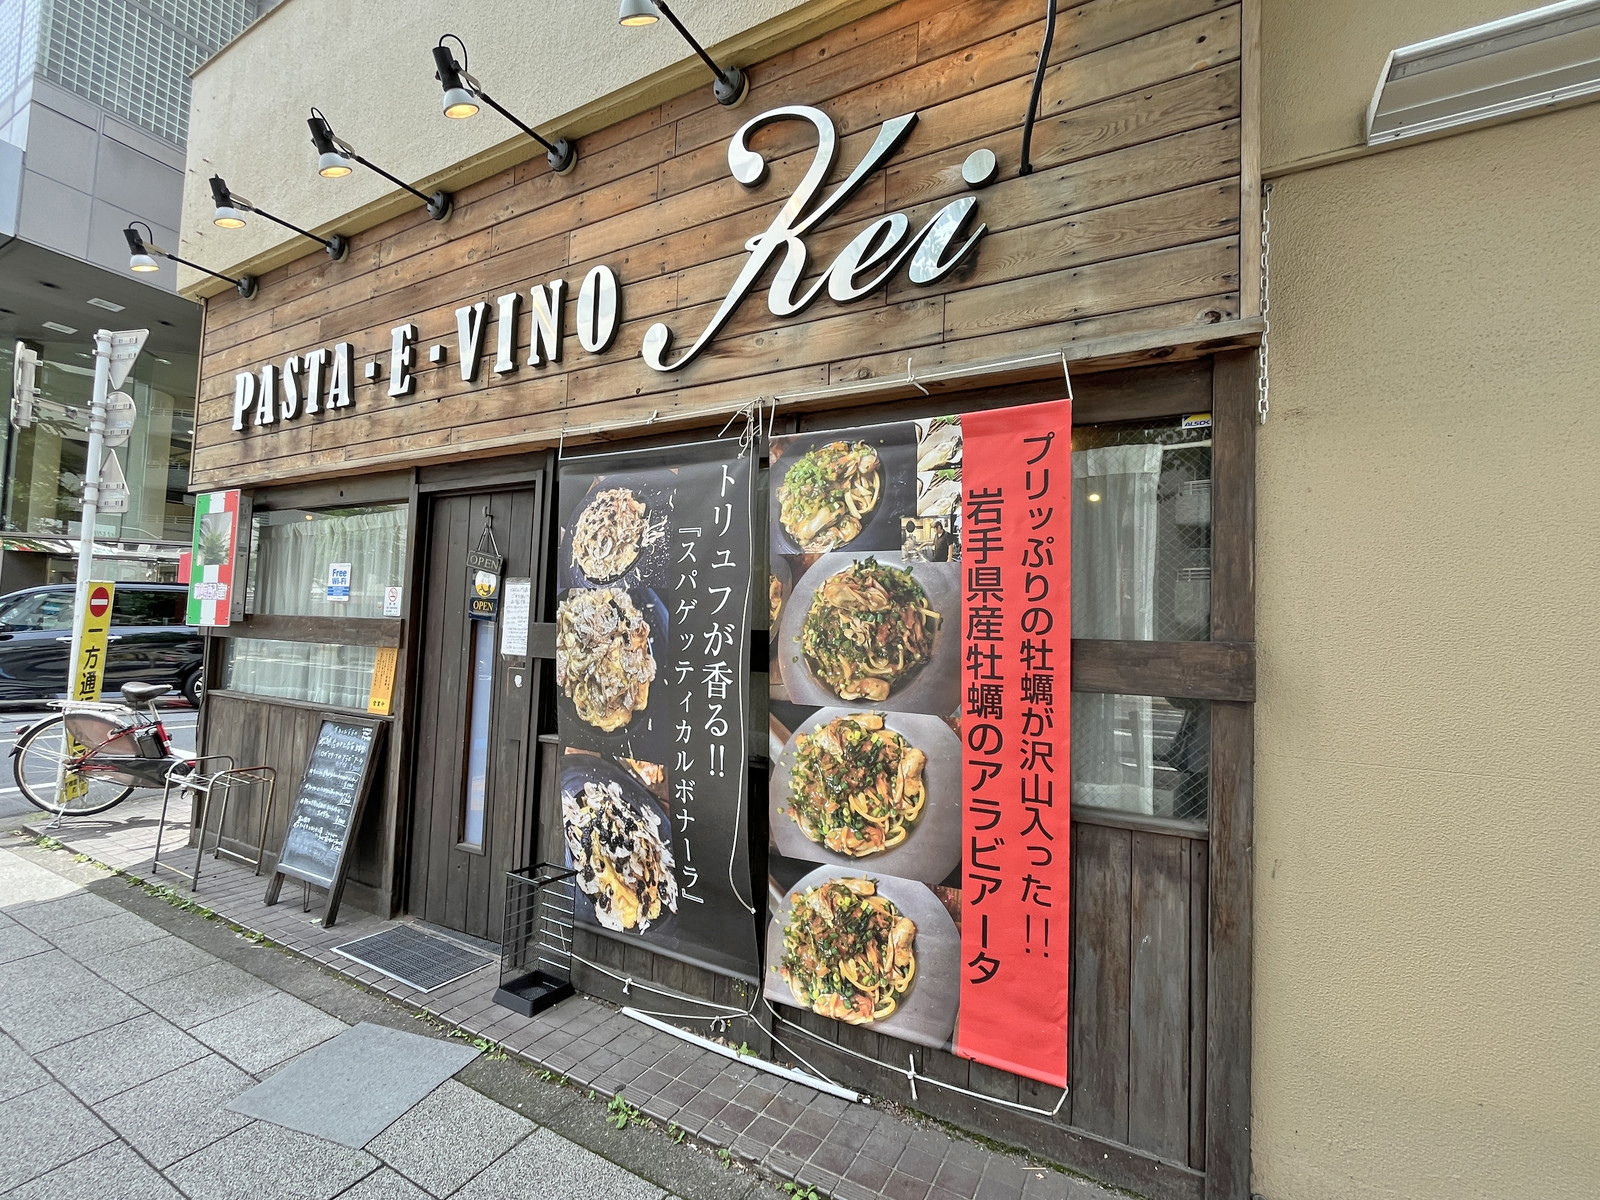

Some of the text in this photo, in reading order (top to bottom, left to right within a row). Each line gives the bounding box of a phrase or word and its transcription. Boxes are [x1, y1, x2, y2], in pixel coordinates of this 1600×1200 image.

[642, 105, 998, 372] Kei
[231, 264, 621, 432] PASTA E VINO
[1185, 419, 1210, 427] ALSOK
[331, 577, 347, 585] Wi-Fi
[332, 568, 347, 577] Free
[469, 555, 500, 571] OPEN
[473, 600, 494, 612] OPEN
[700, 464, 737, 778] トリュフが香る!!
[79, 628, 104, 701] 一方通
[674, 527, 704, 904] 『スパゲッティカルボナーラ』
[966, 487, 1005, 984] 岩手県産牡蠣のアラビアータ
